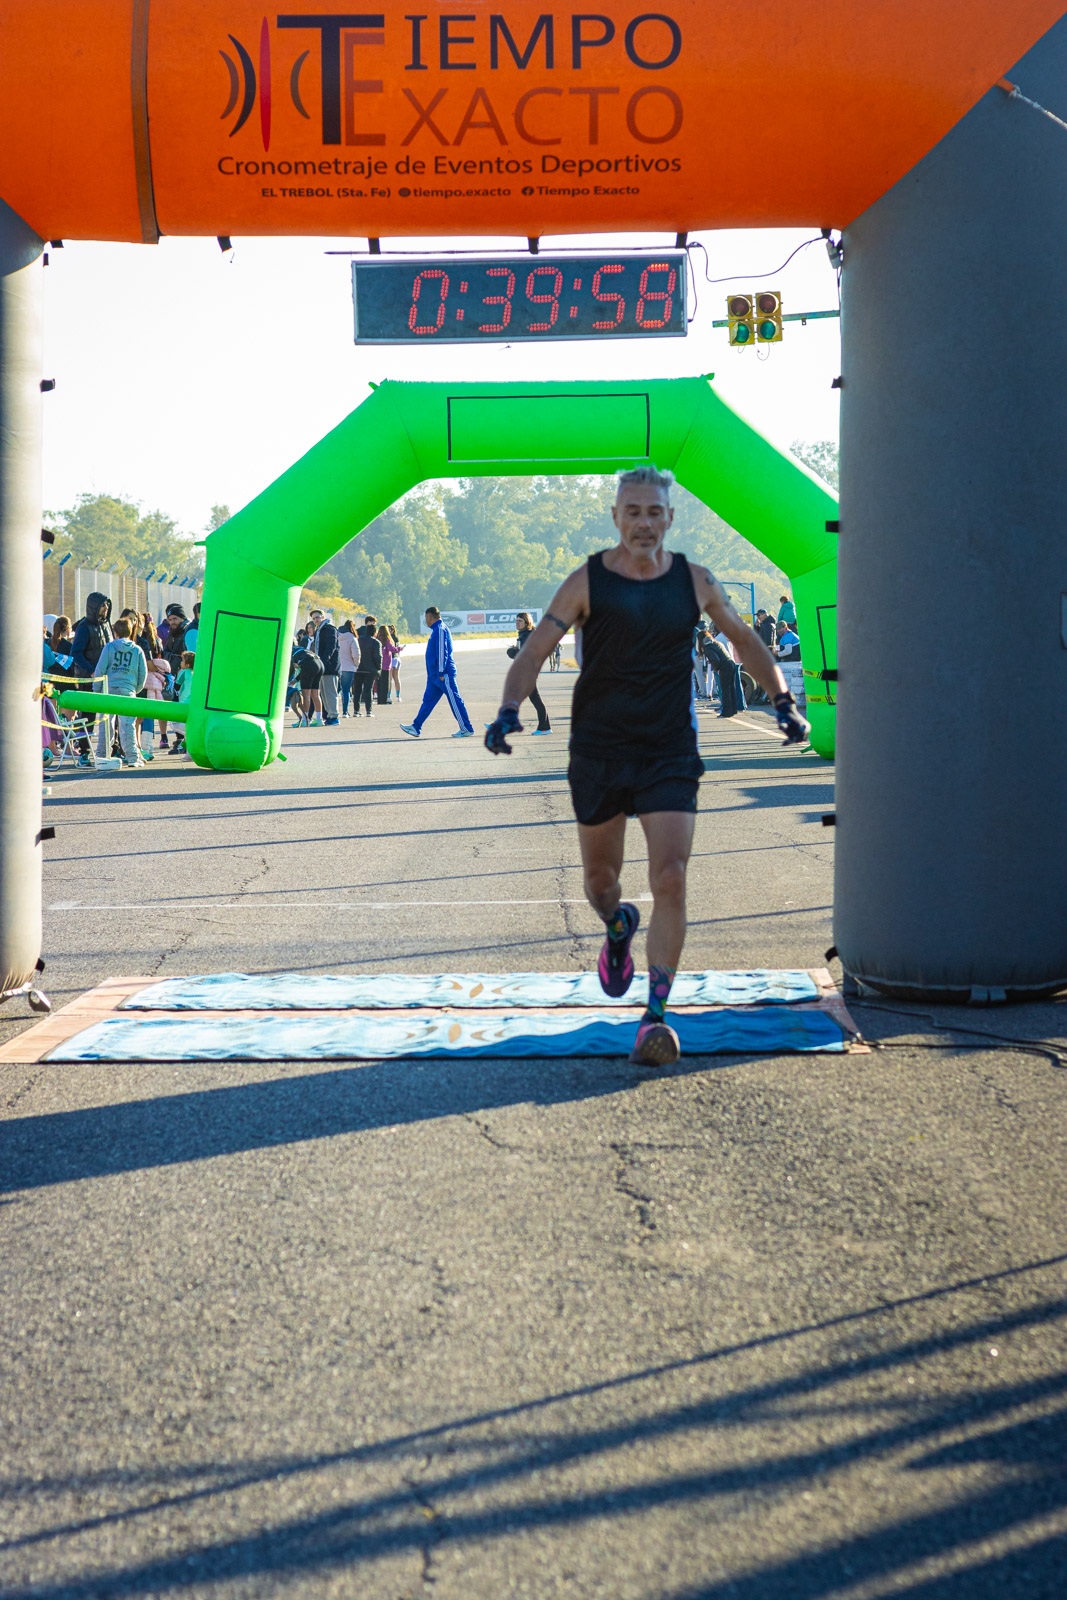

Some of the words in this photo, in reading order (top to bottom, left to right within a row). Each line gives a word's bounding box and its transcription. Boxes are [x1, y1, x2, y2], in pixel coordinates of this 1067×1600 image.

[217, 156, 388, 179] Cronometraje
[395, 155, 426, 175] de
[434, 155, 533, 175] Eventos
[541, 154, 682, 177] Deportivos
[261, 187, 277, 197] EL
[280, 187, 333, 198] TREBOL
[337, 187, 367, 198] (Sta.
[371, 187, 391, 198] Fe)
[413, 186, 511, 199] tiempo.exacto
[537, 186, 590, 197] Tiempo
[594, 185, 640, 195] Exacto
[409, 263, 677, 335] 0:39:58
